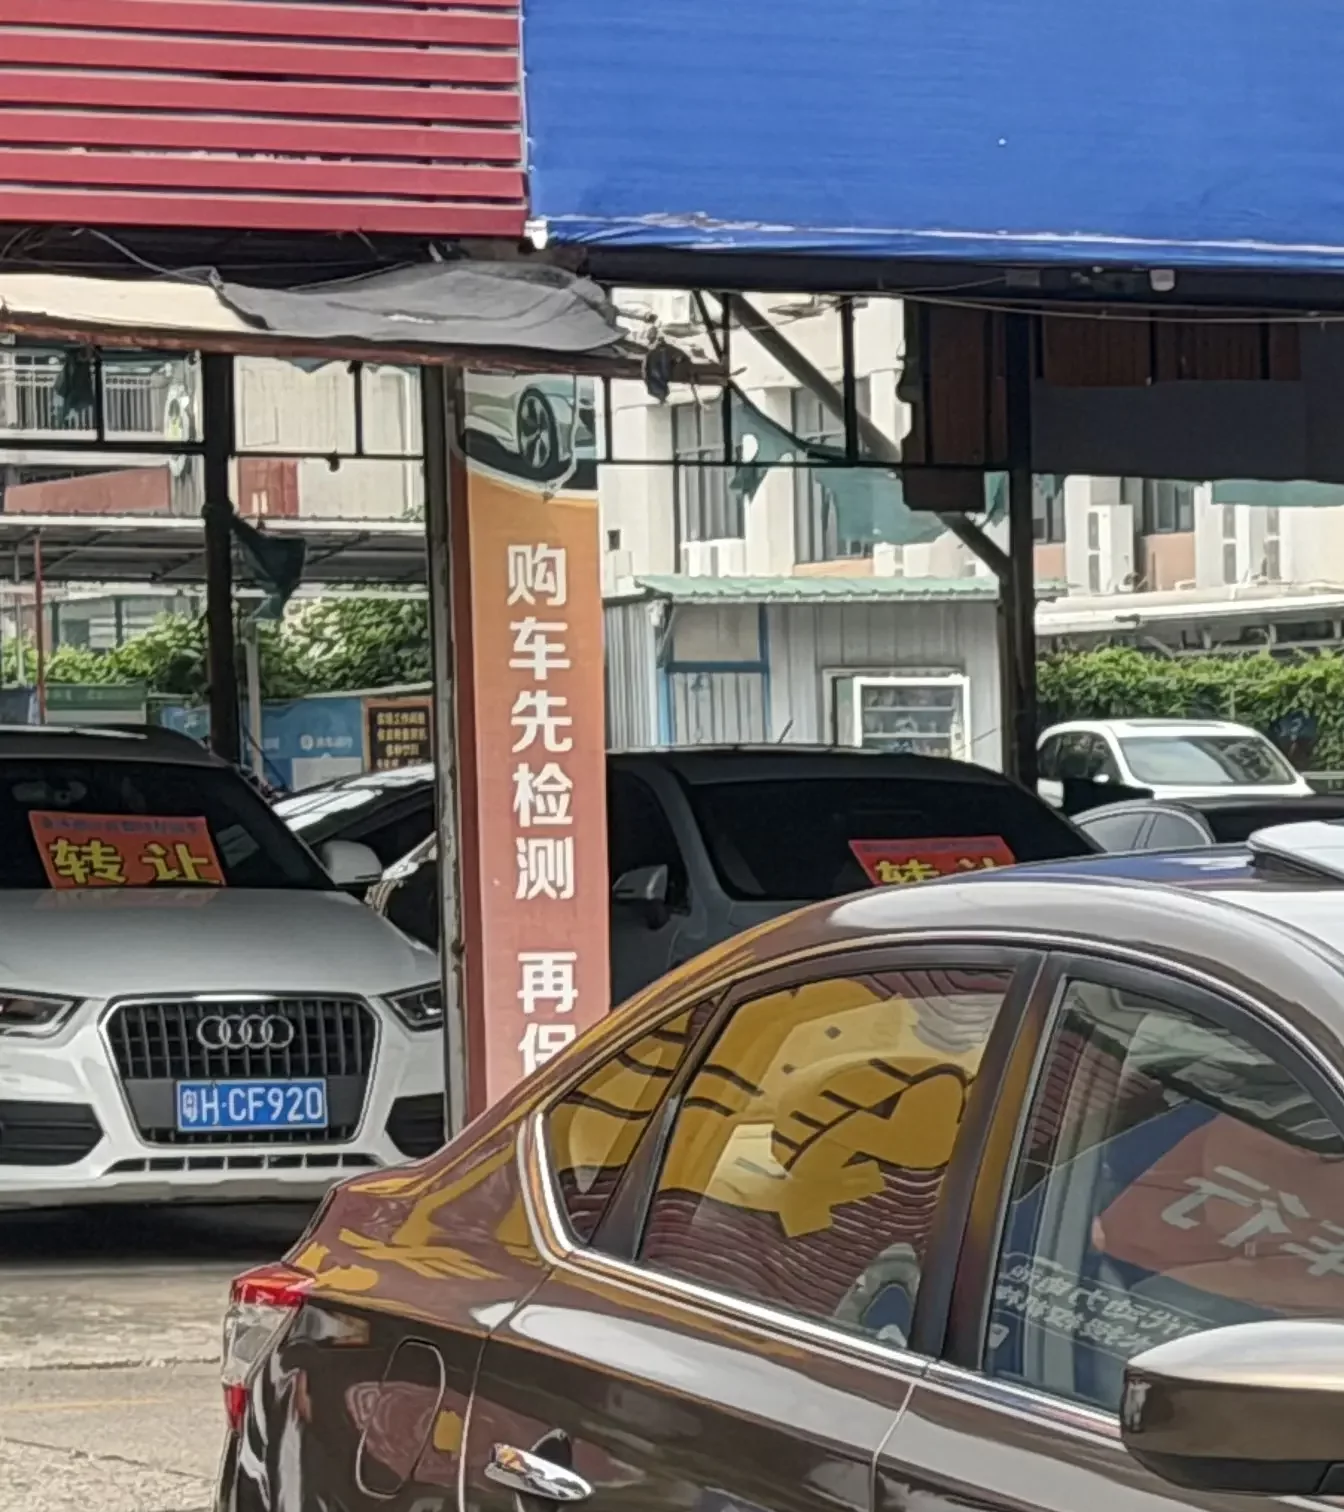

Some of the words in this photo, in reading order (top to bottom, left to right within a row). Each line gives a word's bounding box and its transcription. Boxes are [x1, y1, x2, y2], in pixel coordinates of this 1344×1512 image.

[506, 543, 576, 901] 购车先检测
[49, 838, 221, 884] 转让
